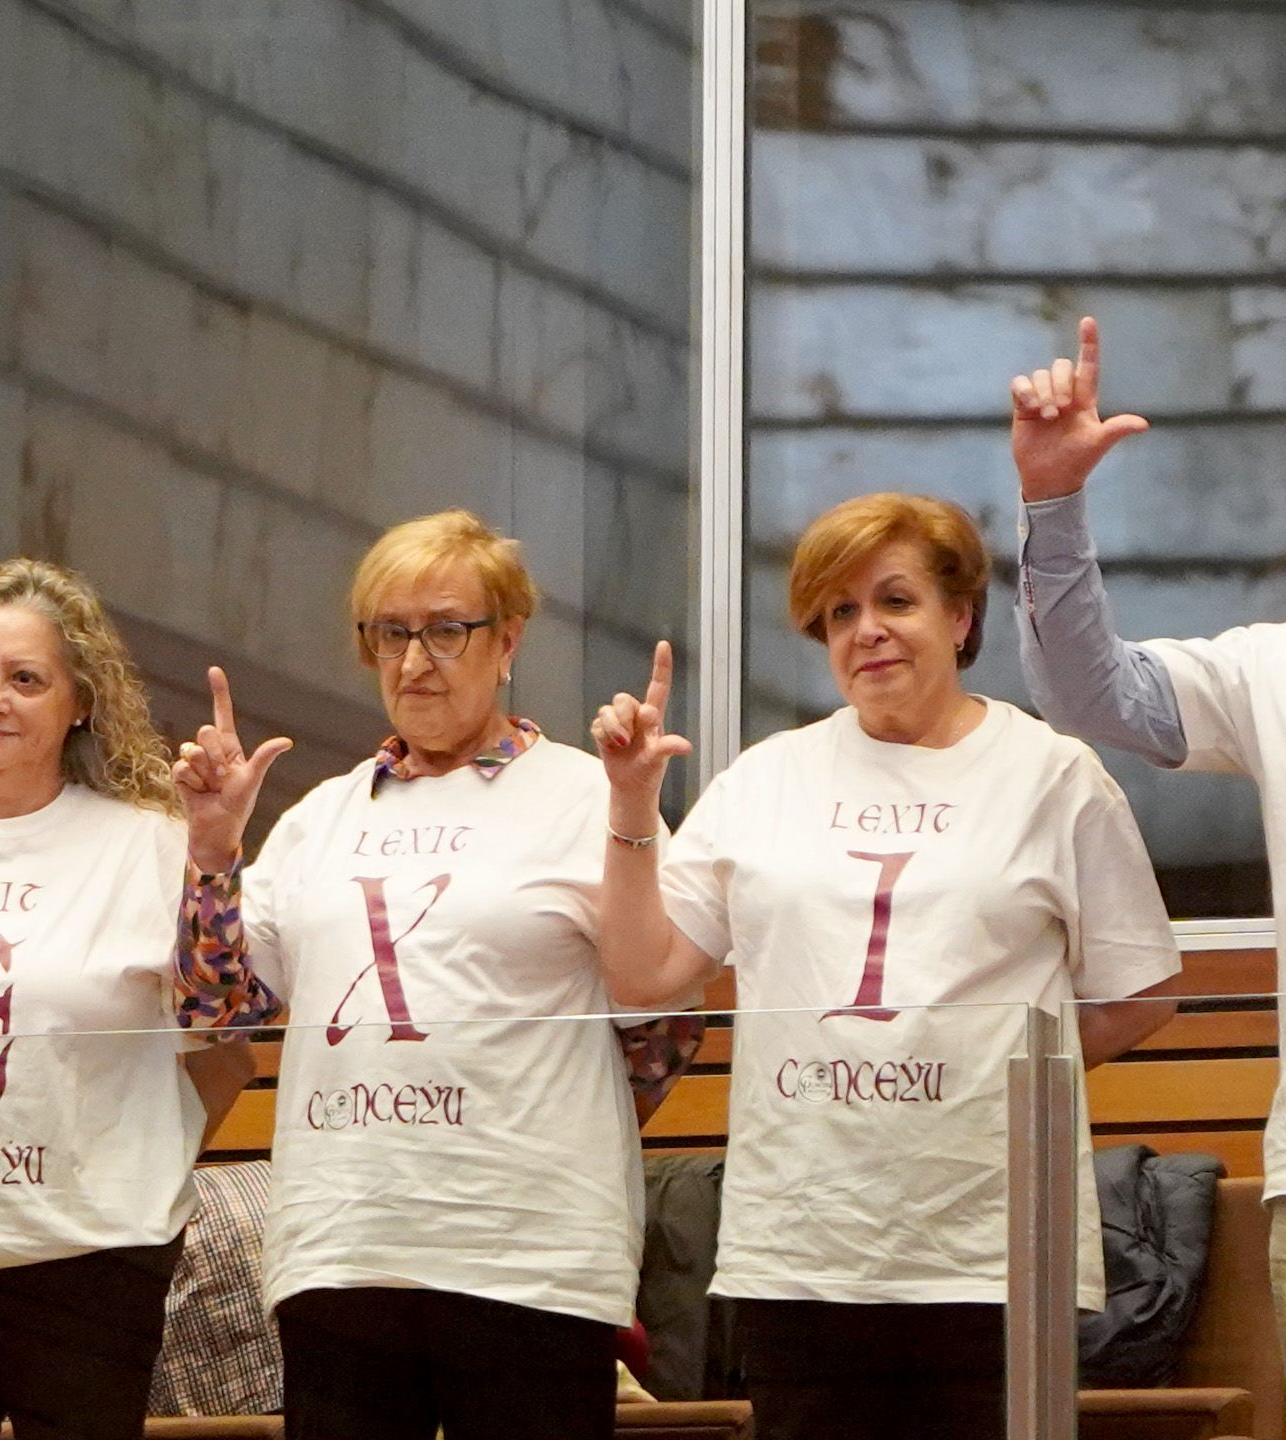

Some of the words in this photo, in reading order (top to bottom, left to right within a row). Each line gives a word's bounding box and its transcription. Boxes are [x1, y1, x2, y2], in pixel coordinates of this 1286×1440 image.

[350, 825, 475, 857] LEXIT
[829, 801, 959, 834] LEXIT
[326, 872, 453, 1047] X
[819, 849, 916, 1023] I
